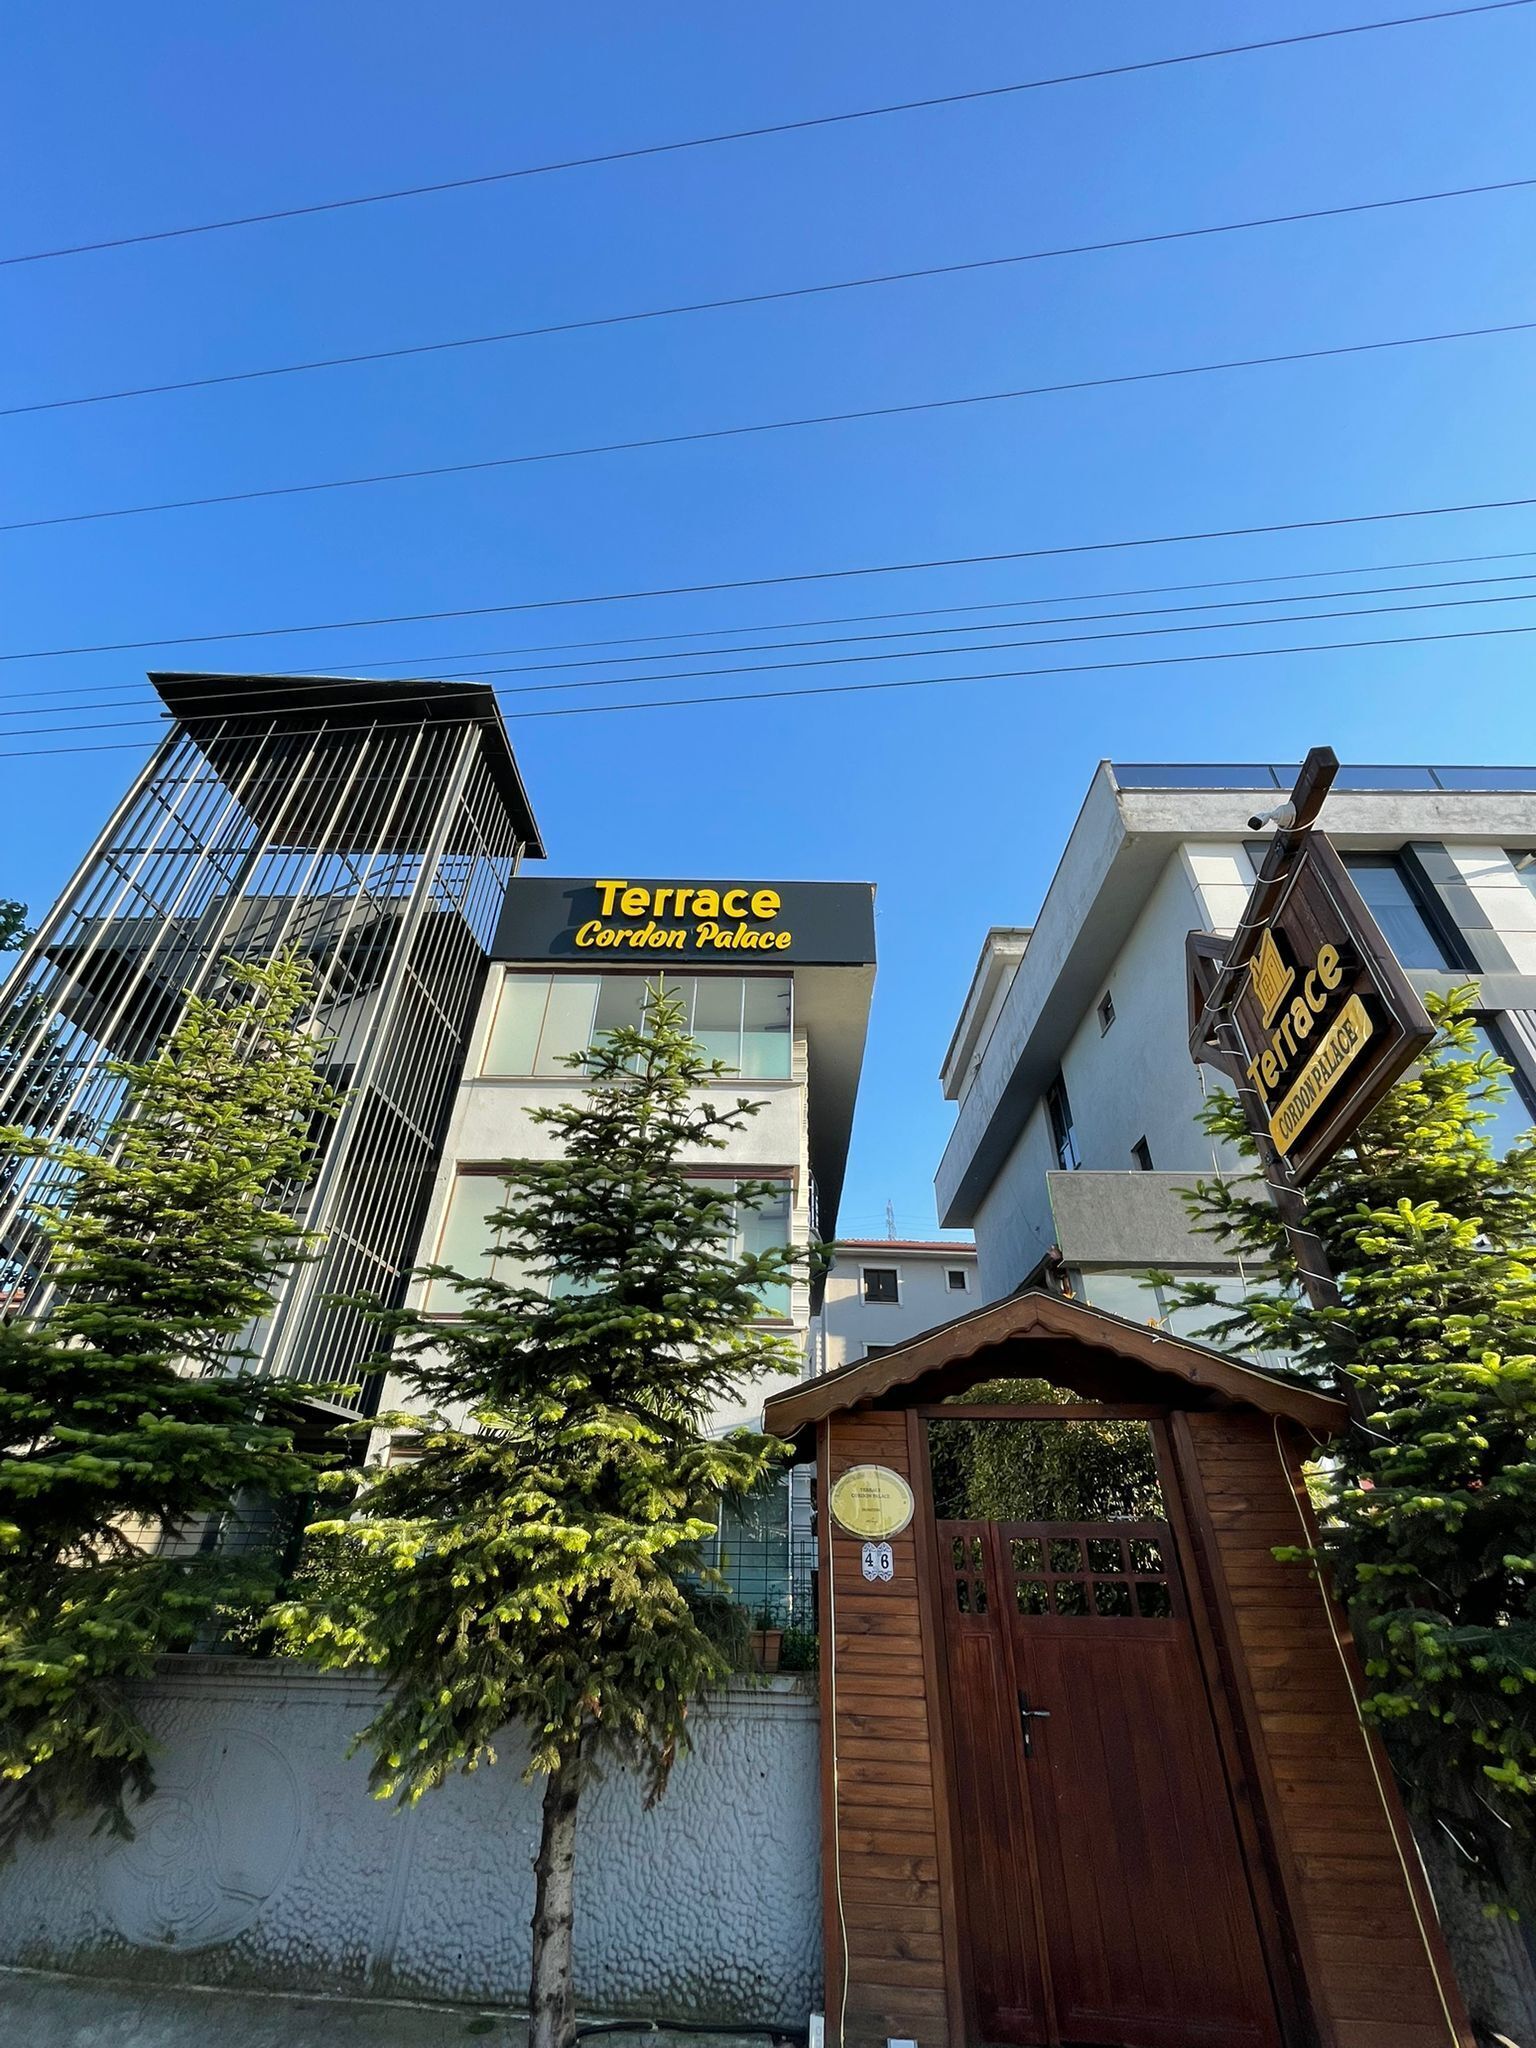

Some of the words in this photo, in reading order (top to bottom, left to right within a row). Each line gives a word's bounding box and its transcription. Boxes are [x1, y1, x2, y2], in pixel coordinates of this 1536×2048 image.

[594, 880, 781, 919] Terrace
[575, 920, 685, 950] Cordon
[695, 922, 792, 951] Palace
[1247, 943, 1343, 1102] Terrace
[1278, 1075, 1317, 1140] CORDON
[1310, 1017, 1359, 1093] PALACE
[864, 1553, 889, 1569] 46
